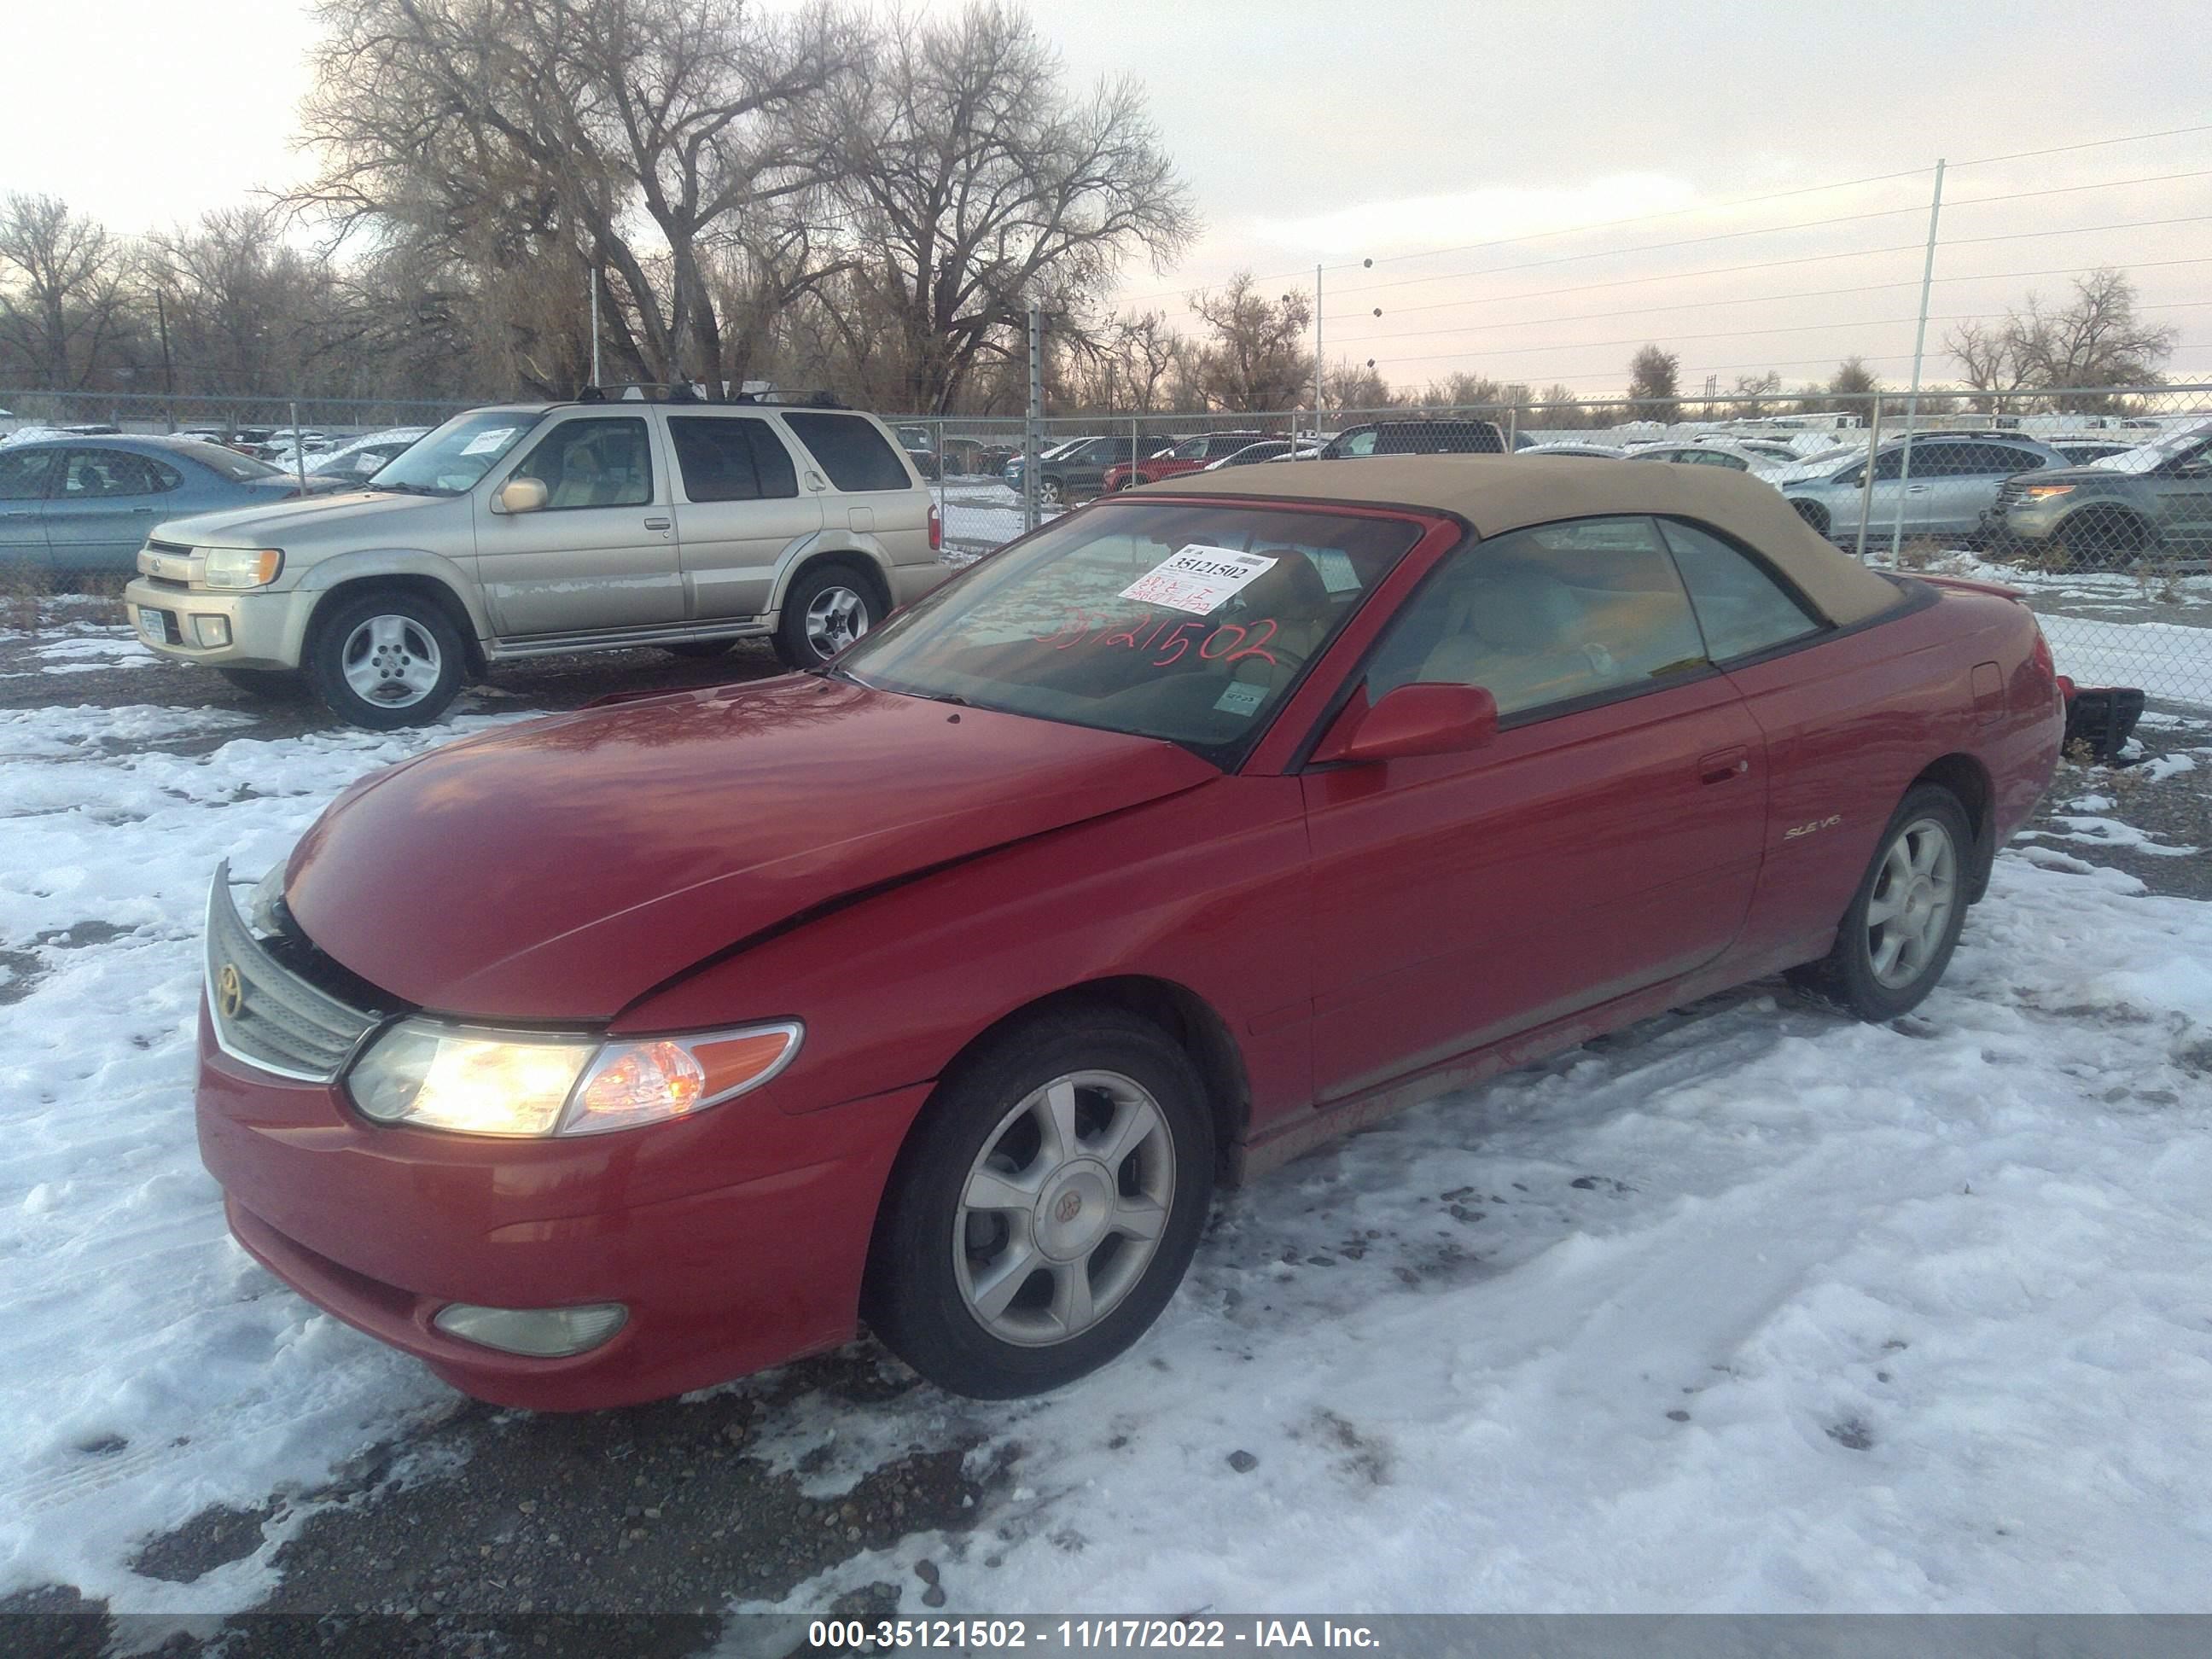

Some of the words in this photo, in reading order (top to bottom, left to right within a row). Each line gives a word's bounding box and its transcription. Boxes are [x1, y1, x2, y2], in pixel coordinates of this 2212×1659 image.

[1169, 557, 1249, 579] 35121502
[1784, 822, 1818, 841] SLE
[1819, 814, 1842, 828] V6
